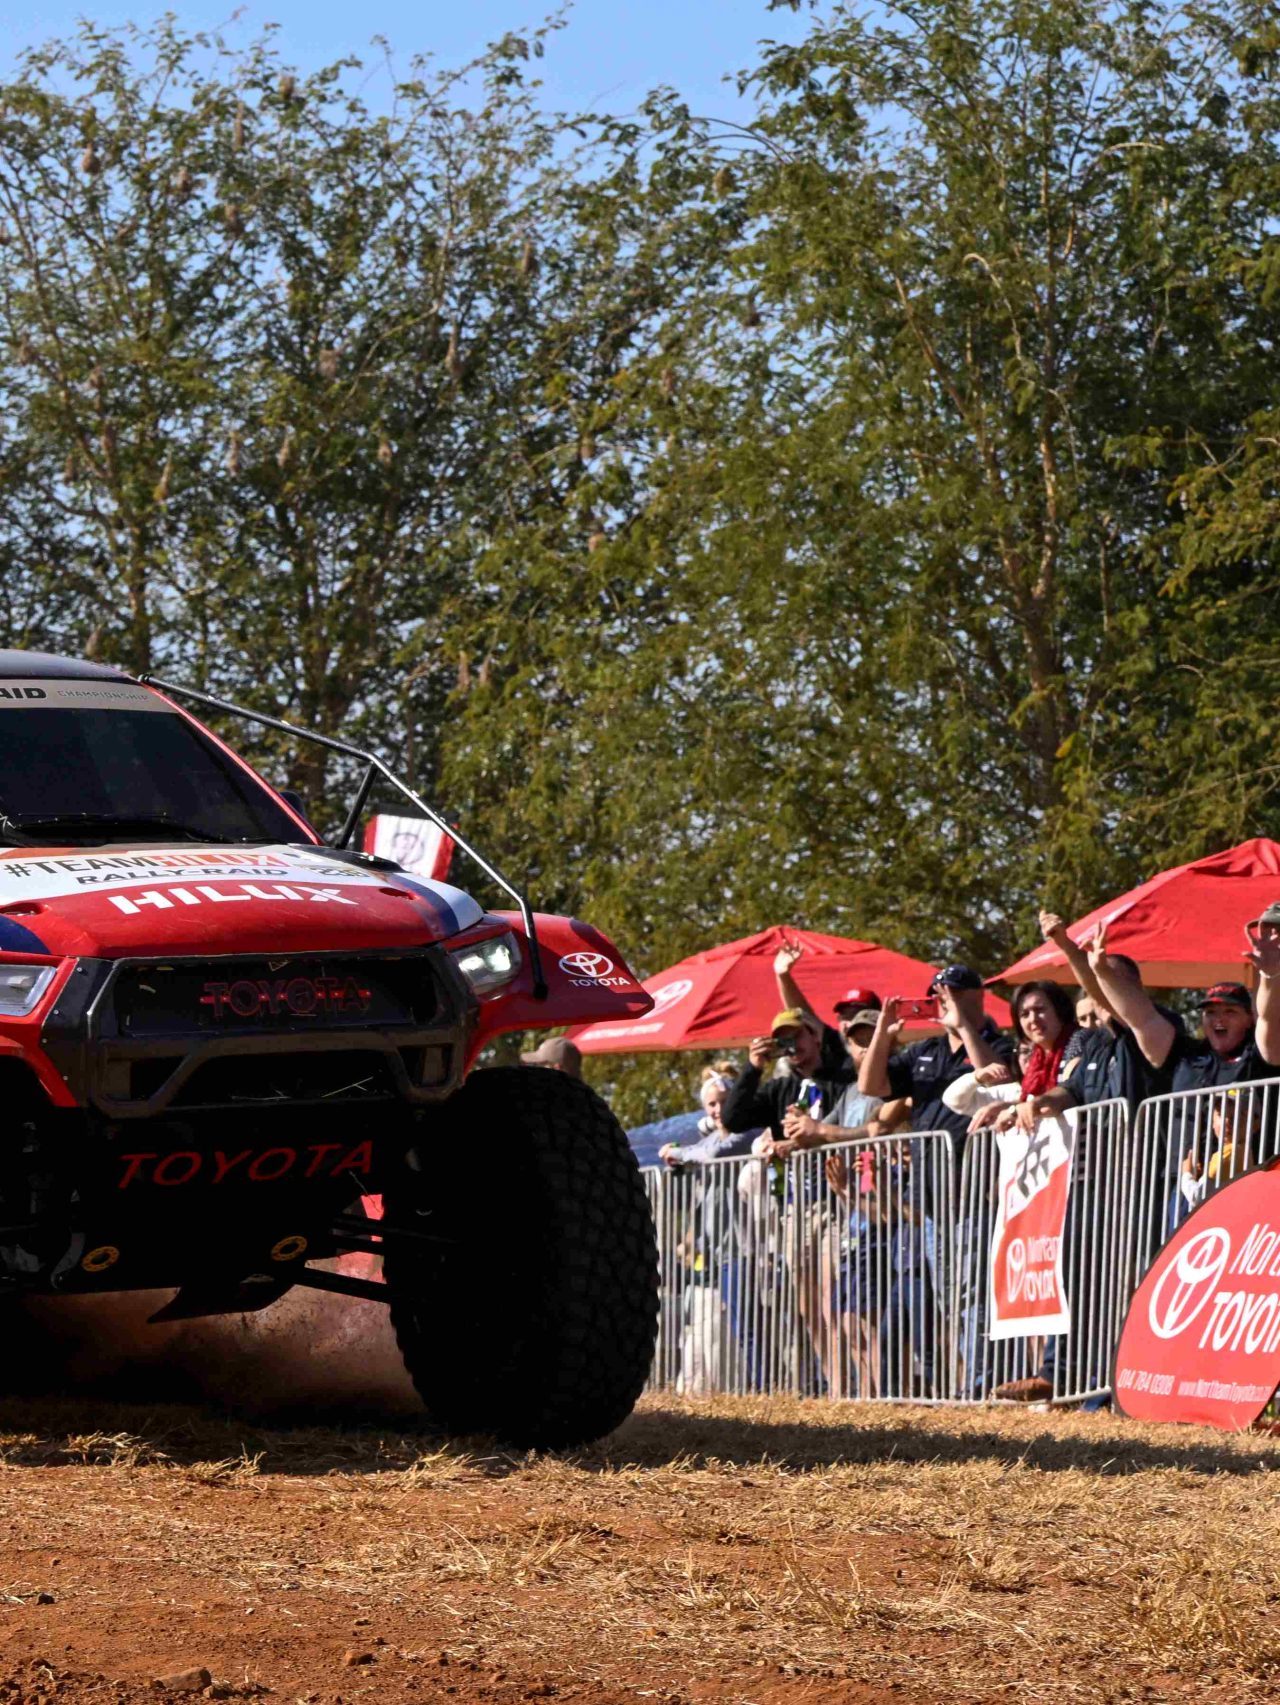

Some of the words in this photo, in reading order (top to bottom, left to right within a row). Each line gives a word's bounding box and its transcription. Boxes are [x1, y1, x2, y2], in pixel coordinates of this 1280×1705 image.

[56, 689, 149, 701] CHAMPIONSHIP
[76, 867, 289, 886] RALLY-RAID
[107, 884, 361, 915] HILUX
[202, 976, 372, 1017] TOYOTA
[568, 976, 631, 988] TOYOTA
[117, 1140, 373, 1189] TOYOTA
[1198, 1290, 1280, 1354] TOYO
